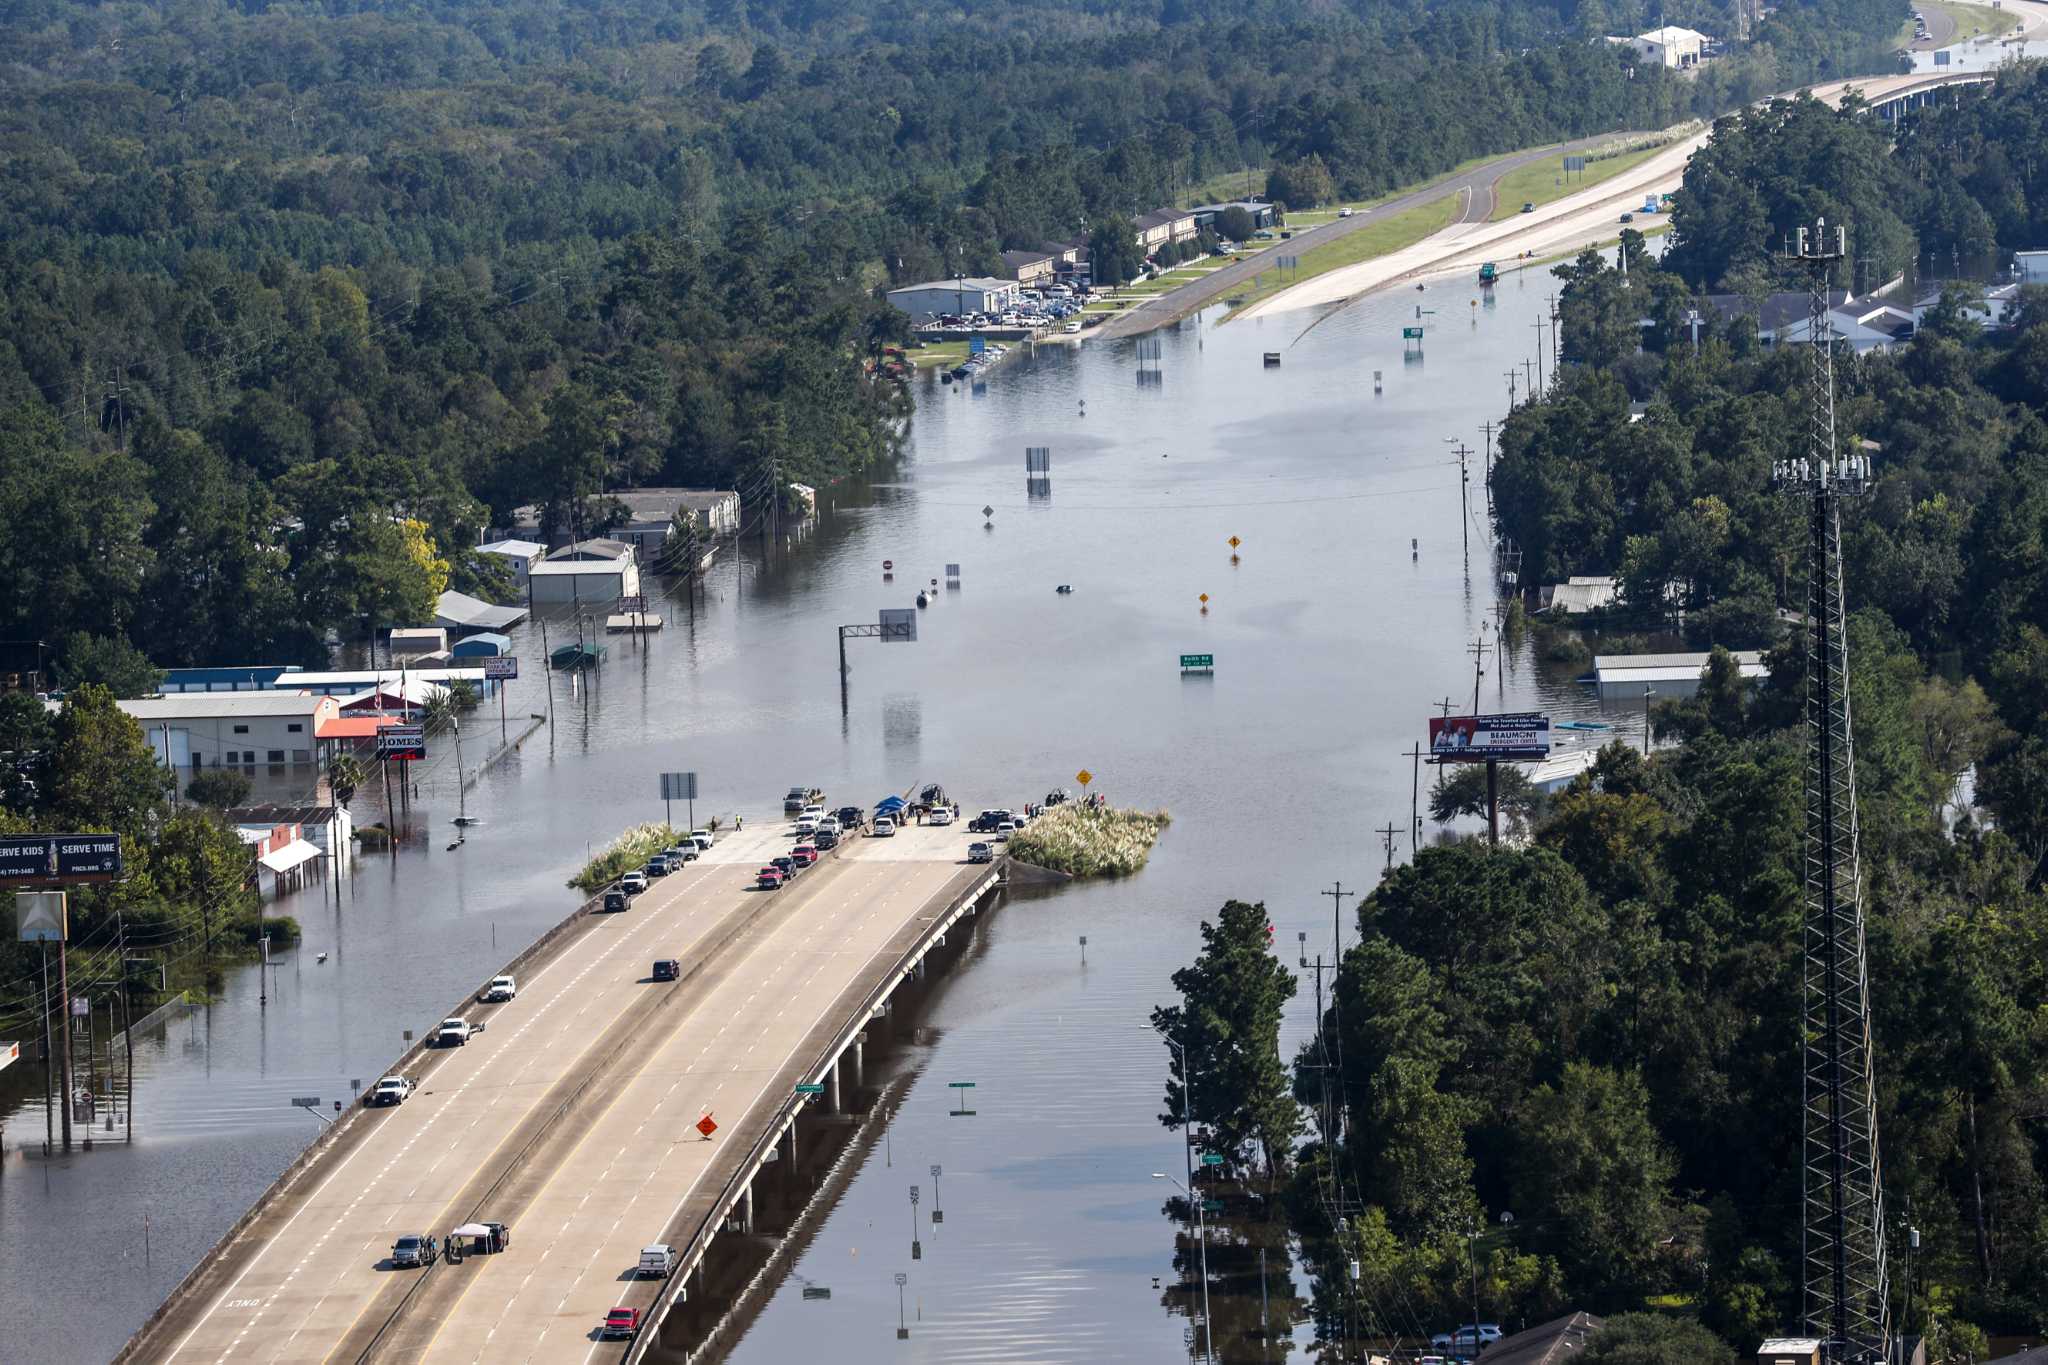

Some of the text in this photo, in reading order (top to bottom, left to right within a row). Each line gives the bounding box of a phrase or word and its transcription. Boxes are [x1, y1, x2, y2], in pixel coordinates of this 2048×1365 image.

[1490, 731, 1537, 739] BEAUMONT
[22, 846, 44, 856] KIDS
[62, 843, 115, 854] SERVE TIME
